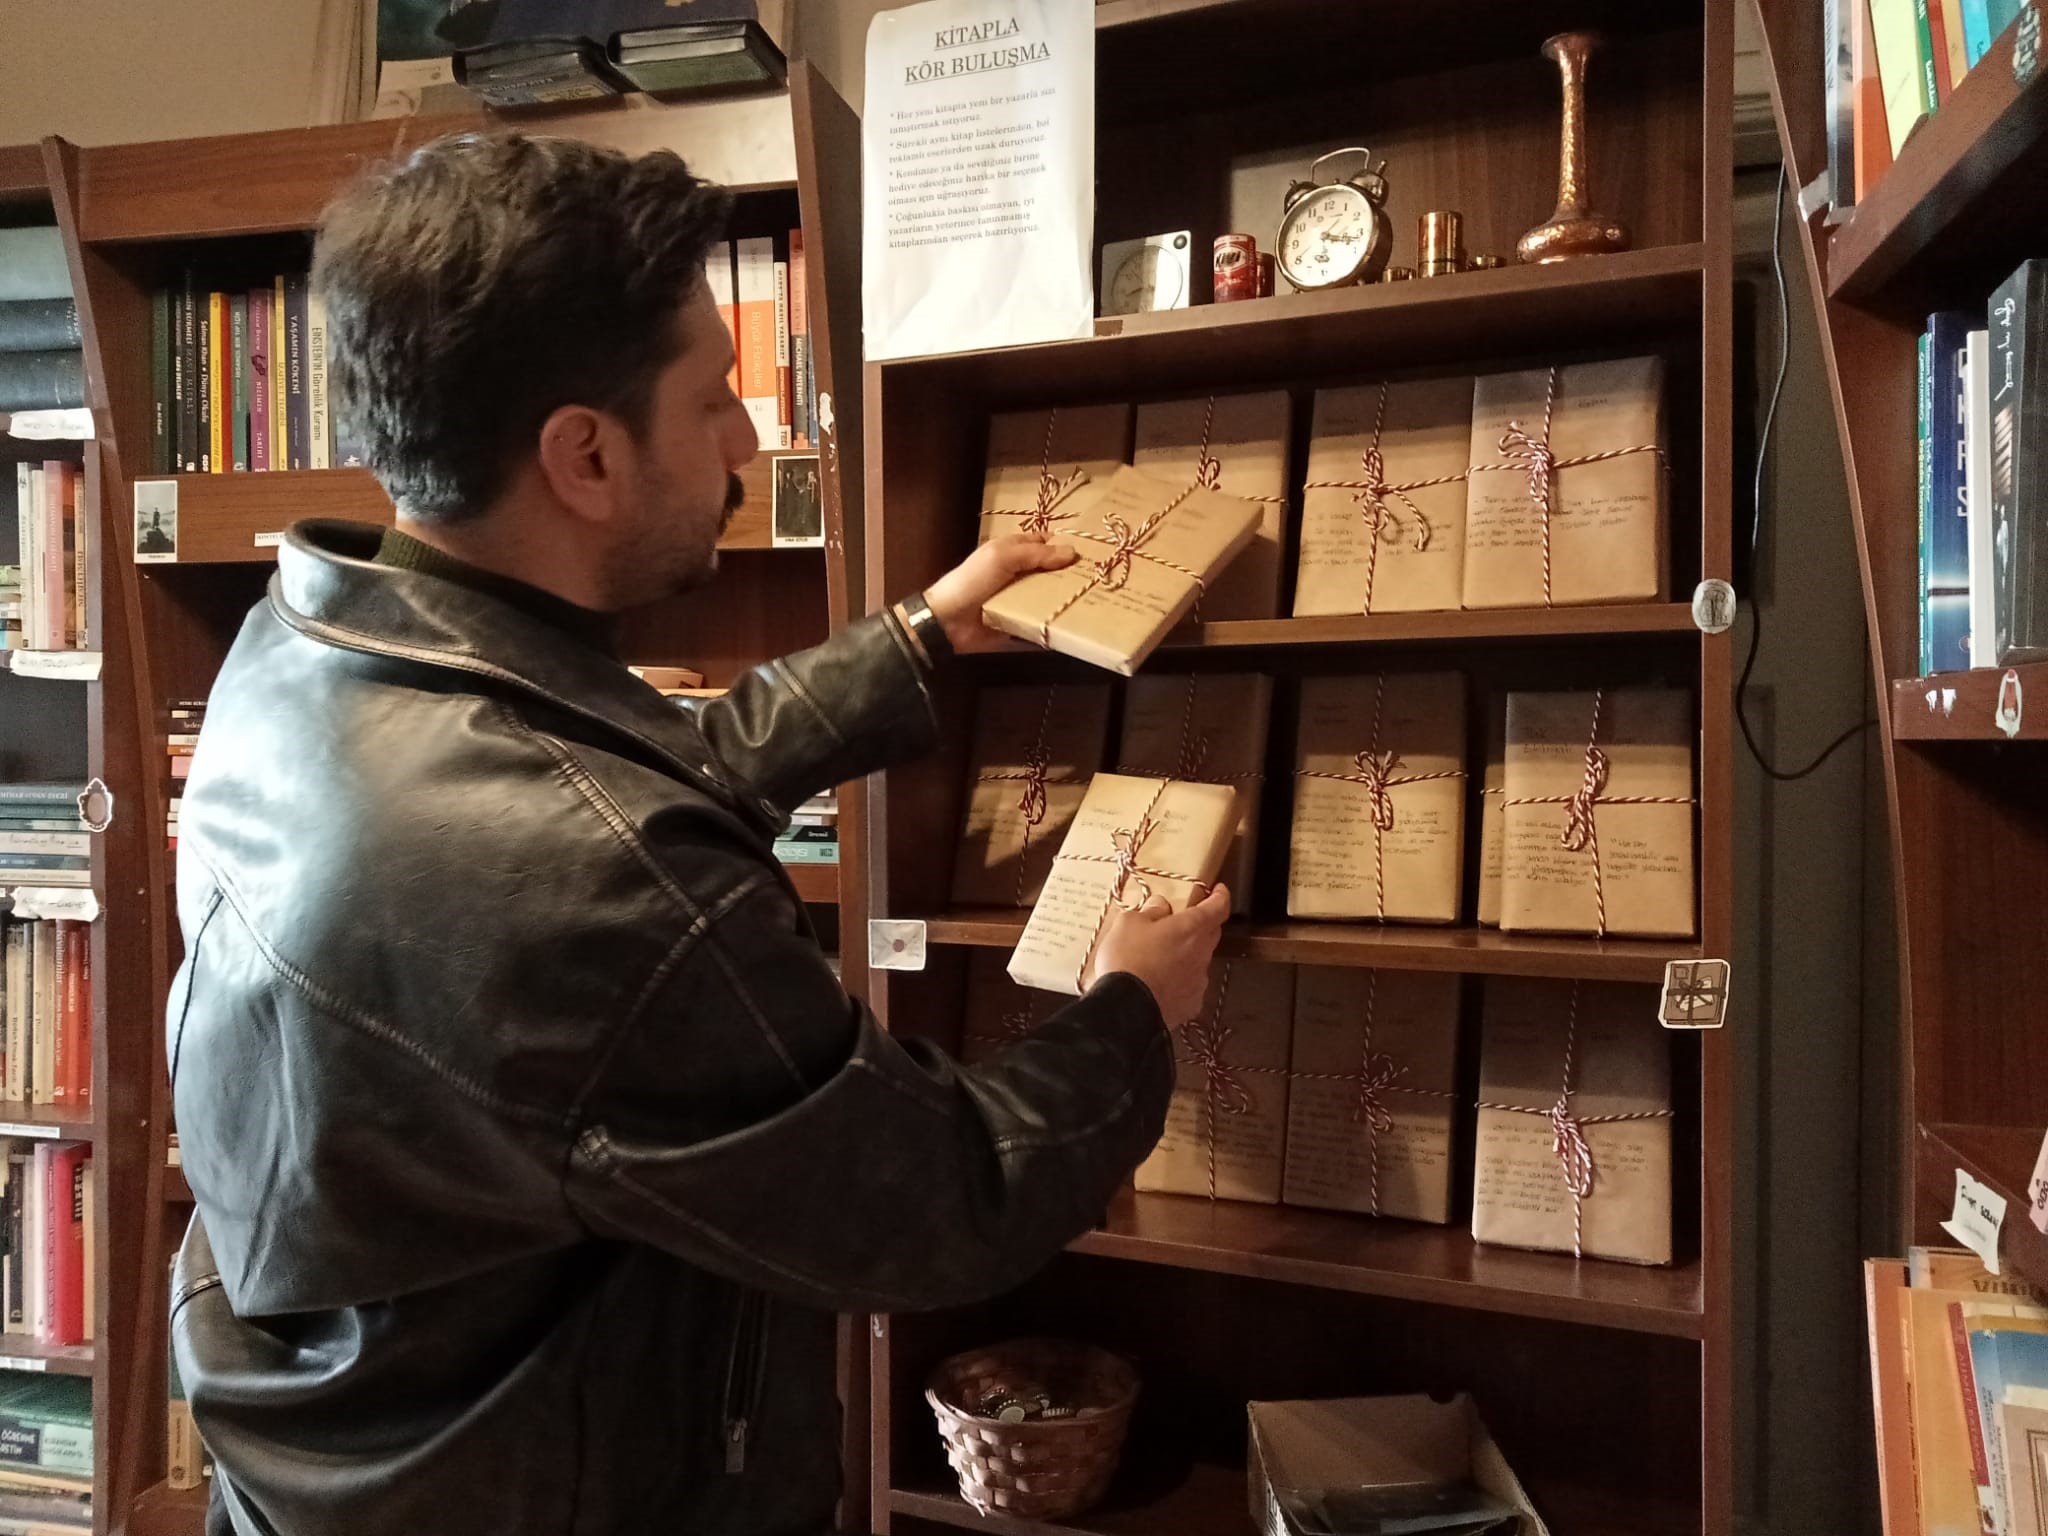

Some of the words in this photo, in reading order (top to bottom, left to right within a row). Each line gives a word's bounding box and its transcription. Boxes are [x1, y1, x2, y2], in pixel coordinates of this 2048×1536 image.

[935, 17, 1020, 49] KİTAPLA
[905, 59, 945, 83] KÖR
[951, 42, 1051, 74] BULUŞMA
[990, 95, 1003, 105] bir
[951, 129, 974, 144] kitap
[975, 141, 996, 152] uzak
[953, 161, 965, 172] da
[997, 168, 1010, 179] bir
[290, 315, 300, 358] YAŞAMIN
[795, 337, 803, 370] MICHAEL
[291, 359, 301, 395] KÖKENİ
[780, 431, 788, 447] TED
